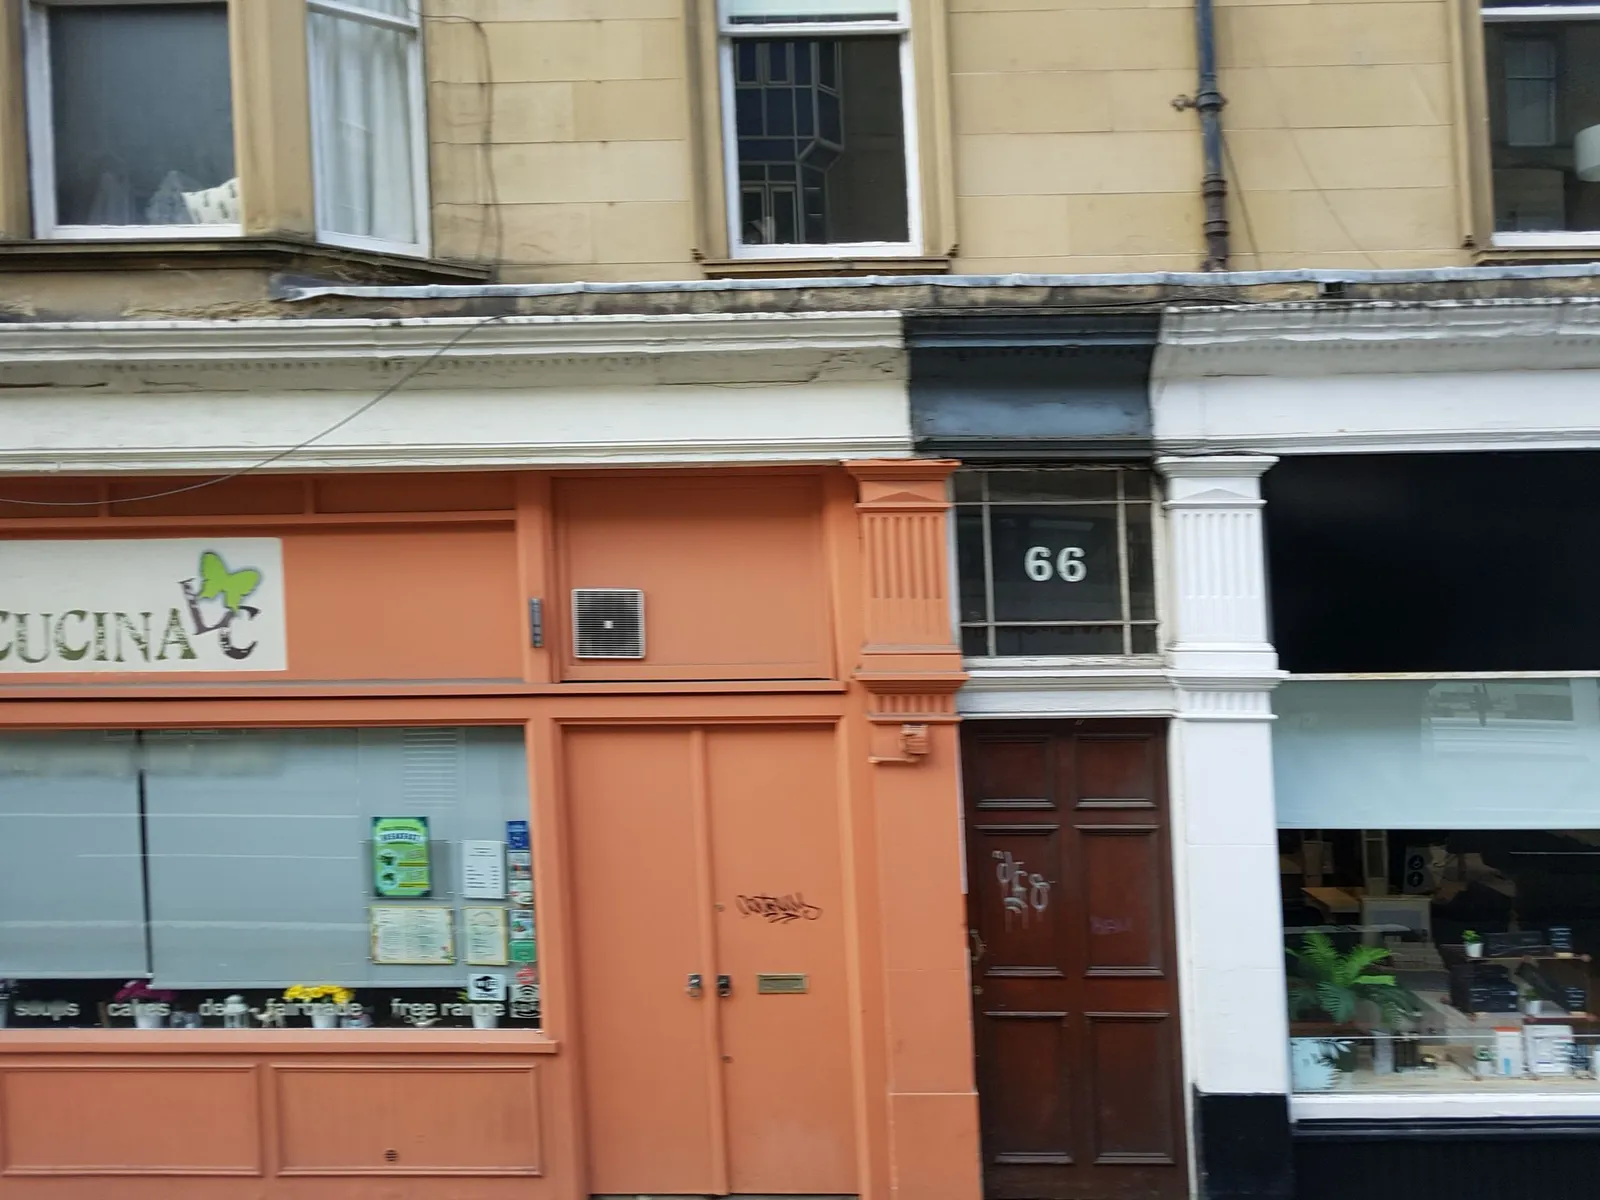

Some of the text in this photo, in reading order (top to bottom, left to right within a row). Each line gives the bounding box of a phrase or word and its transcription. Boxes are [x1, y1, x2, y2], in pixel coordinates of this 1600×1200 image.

[1024, 546, 1087, 582] 66
[14, 1001, 80, 1021] soups
[107, 998, 171, 1017] cakes
[390, 998, 437, 1016] free
